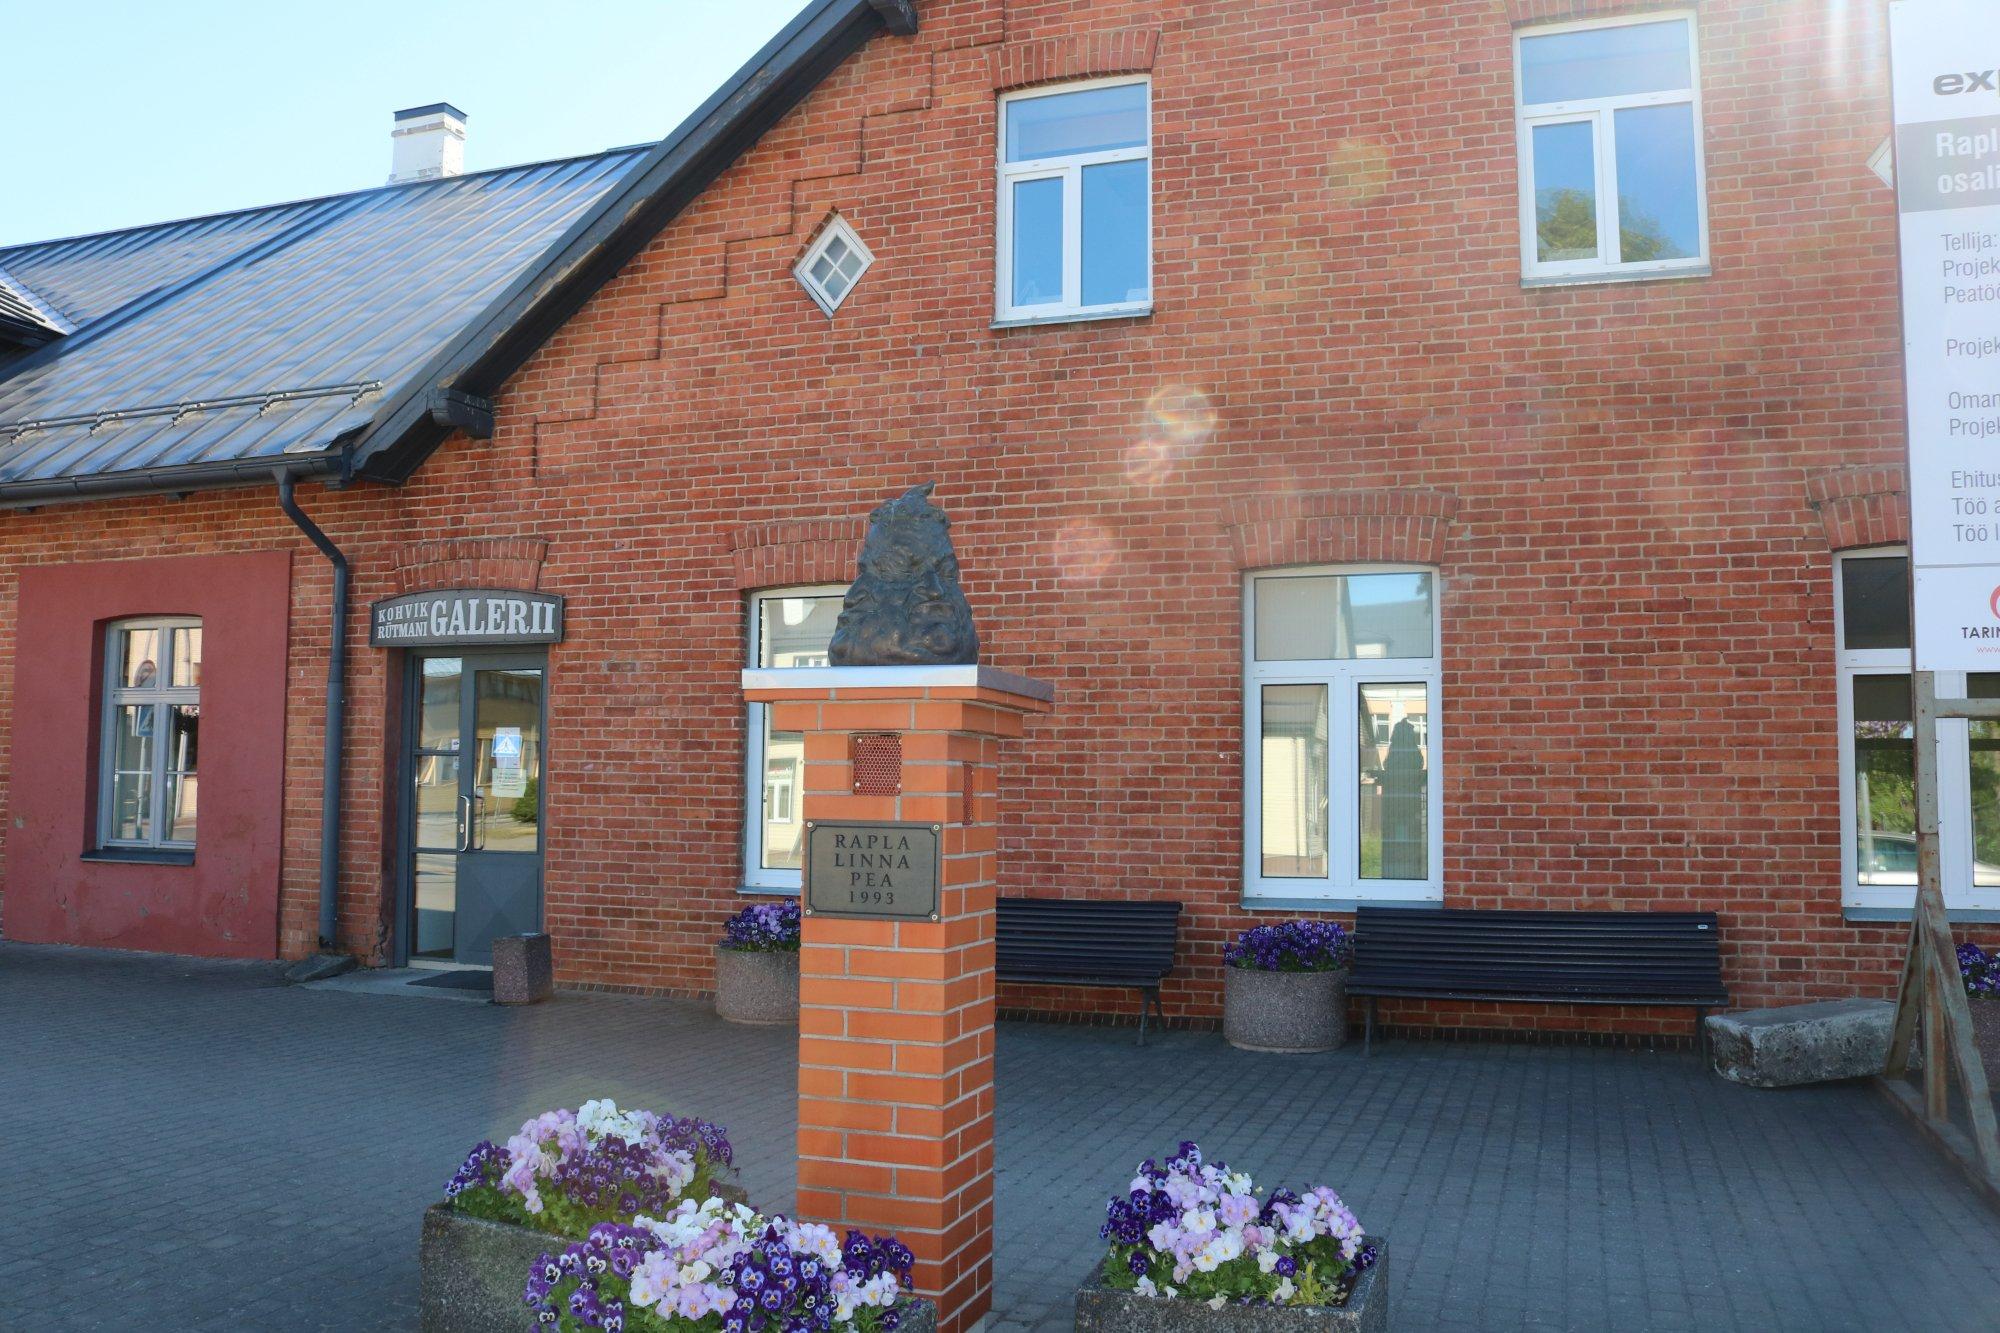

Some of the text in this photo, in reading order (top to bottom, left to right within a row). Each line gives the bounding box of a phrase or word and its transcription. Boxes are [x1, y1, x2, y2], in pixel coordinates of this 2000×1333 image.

[1932, 69, 2000, 95] ex
[1936, 127, 2000, 159] Rapl
[1941, 231, 1998, 252] Tellija:
[1943, 257, 2000, 279] Projek
[1952, 497, 1987, 515] Töö
[1952, 523, 1988, 542] Töö
[378, 602, 428, 622] KOHVIK
[430, 599, 555, 637] GALERII
[834, 834, 911, 851] RAPLA
[833, 853, 910, 869] LINNA
[851, 872, 893, 887] PEA
[850, 891, 894, 904] 1993
